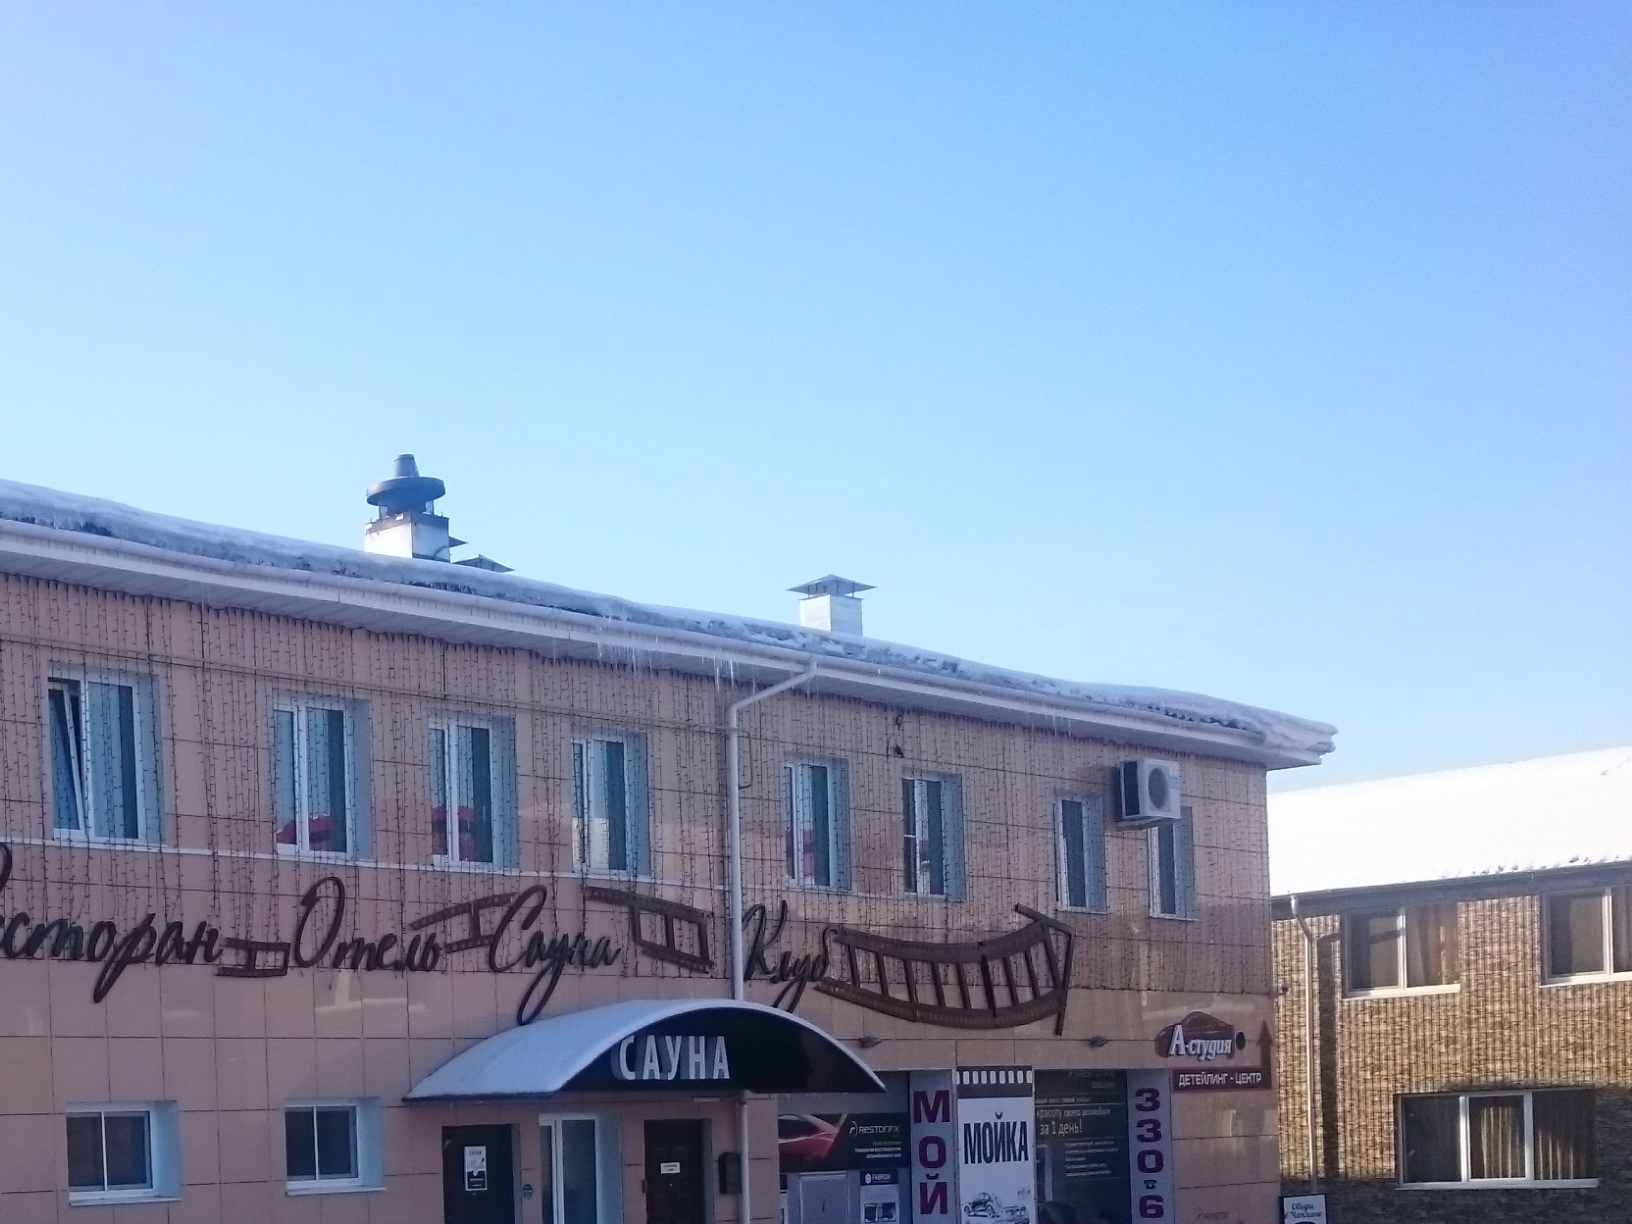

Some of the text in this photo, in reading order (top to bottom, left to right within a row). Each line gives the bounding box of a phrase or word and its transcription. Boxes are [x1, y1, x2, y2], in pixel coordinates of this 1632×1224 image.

[294, 877, 442, 972] Отель
[489, 885, 622, 1026] Сауна
[617, 1034, 730, 1081] САУНА
[1170, 1024, 1233, 1061] А-студия
[1179, 1072, 1228, 1087] ДЕТЕЙЛИНГ
[1235, 1072, 1262, 1085] ЦЕНТР
[963, 1111, 1029, 1165] МОЙКА
[1039, 1124, 1049, 1135] за
[1057, 1119, 1083, 1136] день!
